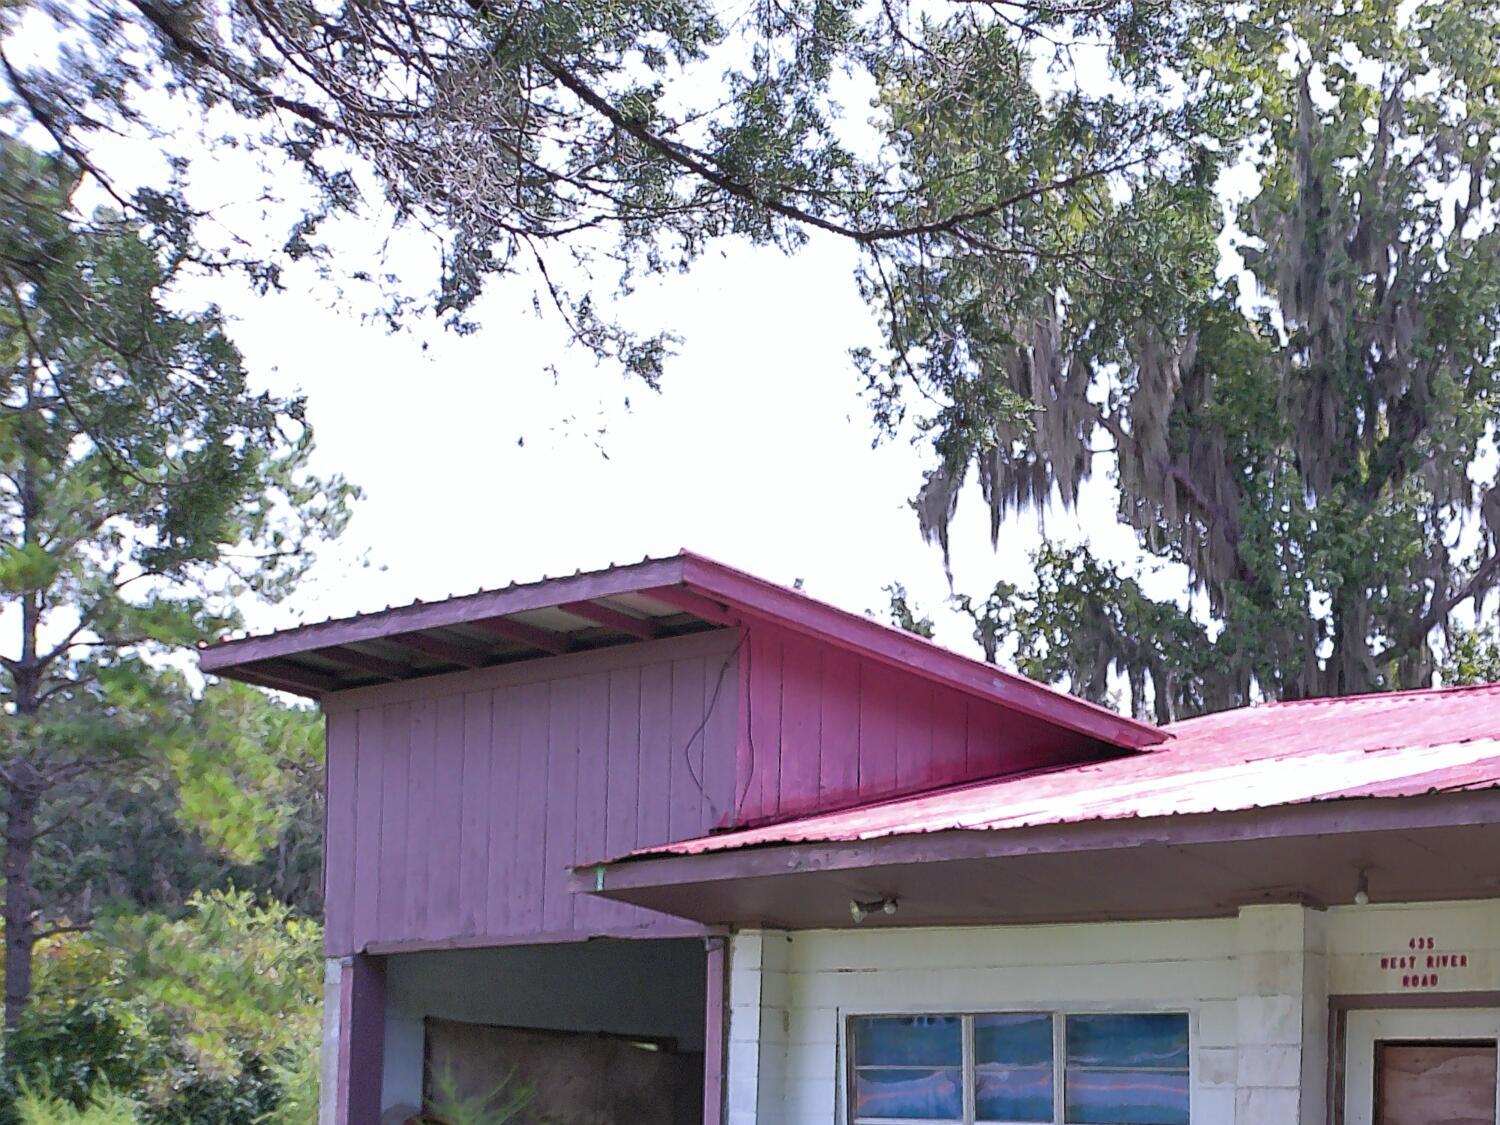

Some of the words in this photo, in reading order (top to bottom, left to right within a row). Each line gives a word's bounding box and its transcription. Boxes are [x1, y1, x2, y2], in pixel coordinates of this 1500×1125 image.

[1408, 936, 1435, 950] 435
[1380, 955, 1417, 970] WEST
[1426, 954, 1468, 969] RIVER
[1402, 973, 1439, 988] ROAD
